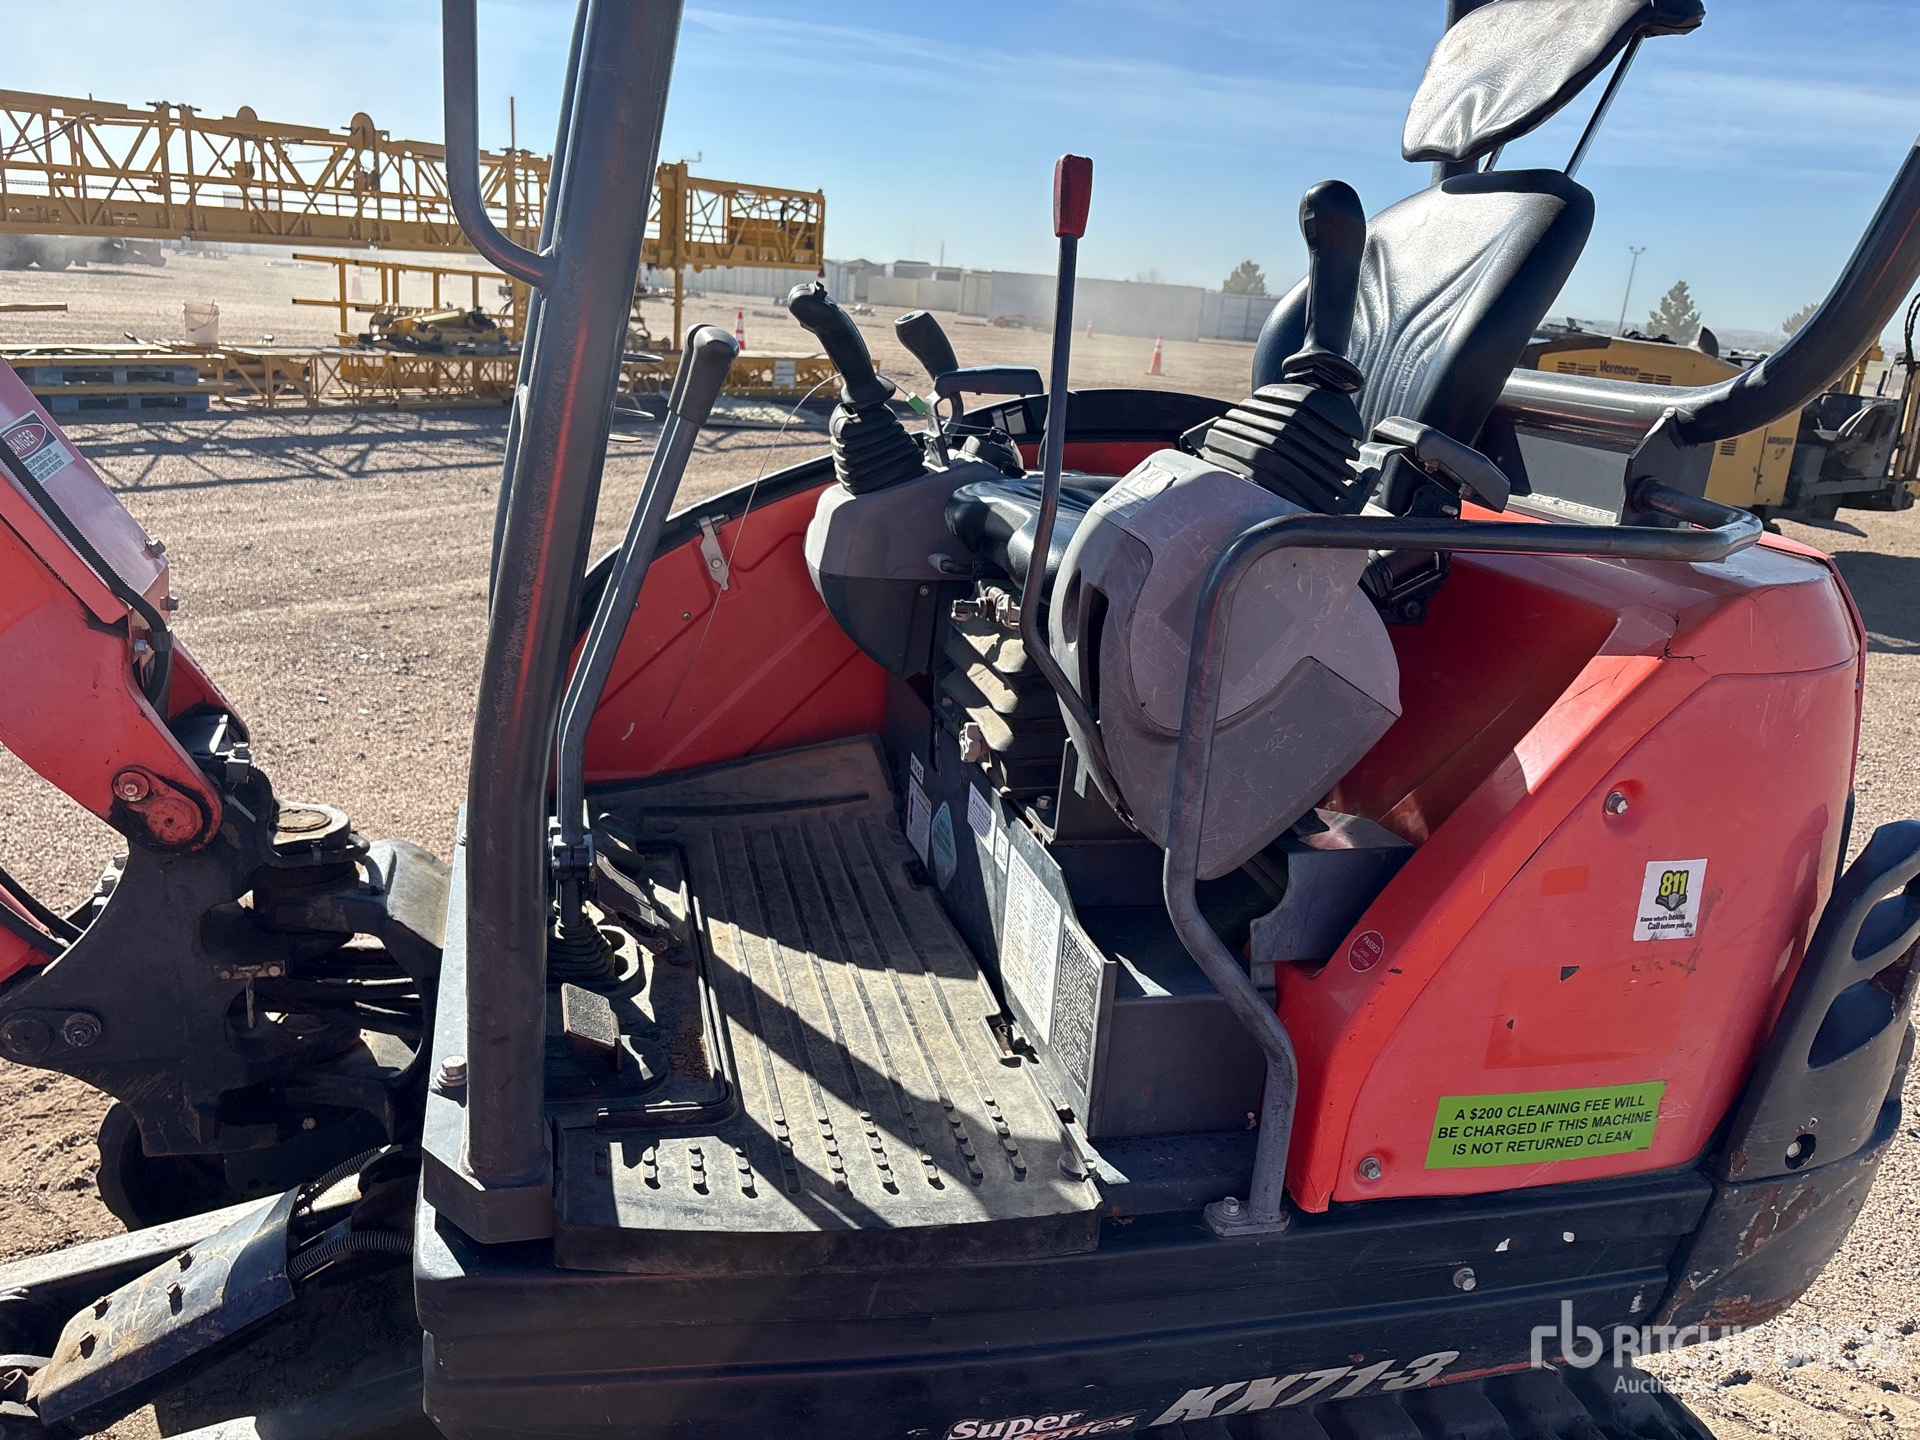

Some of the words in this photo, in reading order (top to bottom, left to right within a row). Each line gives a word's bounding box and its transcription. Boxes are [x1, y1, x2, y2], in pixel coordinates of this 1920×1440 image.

[1600, 360, 1639, 376] Vermeer
[6, 430, 38, 455] DANGER
[1660, 871, 1688, 896] 811
[1647, 922, 1660, 930] Call
[1363, 936, 1381, 954] PASSED
[1454, 1109, 1466, 1121] A
[1470, 1107, 1503, 1121] $200
[1506, 1101, 1580, 1118] CLEANING
[1583, 1098, 1611, 1112] FEE
[1614, 1095, 1645, 1109] WILL
[1437, 1126, 1459, 1140] BE
[1462, 1121, 1537, 1138] CHARGED
[1540, 1120, 1554, 1133] IF
[1557, 1116, 1589, 1132] THIS
[1591, 1110, 1654, 1128] MACHINE
[1452, 1143, 1467, 1156] IS
[1470, 1142, 1503, 1155] NOT
[1505, 1135, 1584, 1153] RETURNED
[1586, 1130, 1633, 1146] CLEAN
[1147, 1351, 1461, 1427] KX71-3
[949, 1412, 1086, 1440] Super
